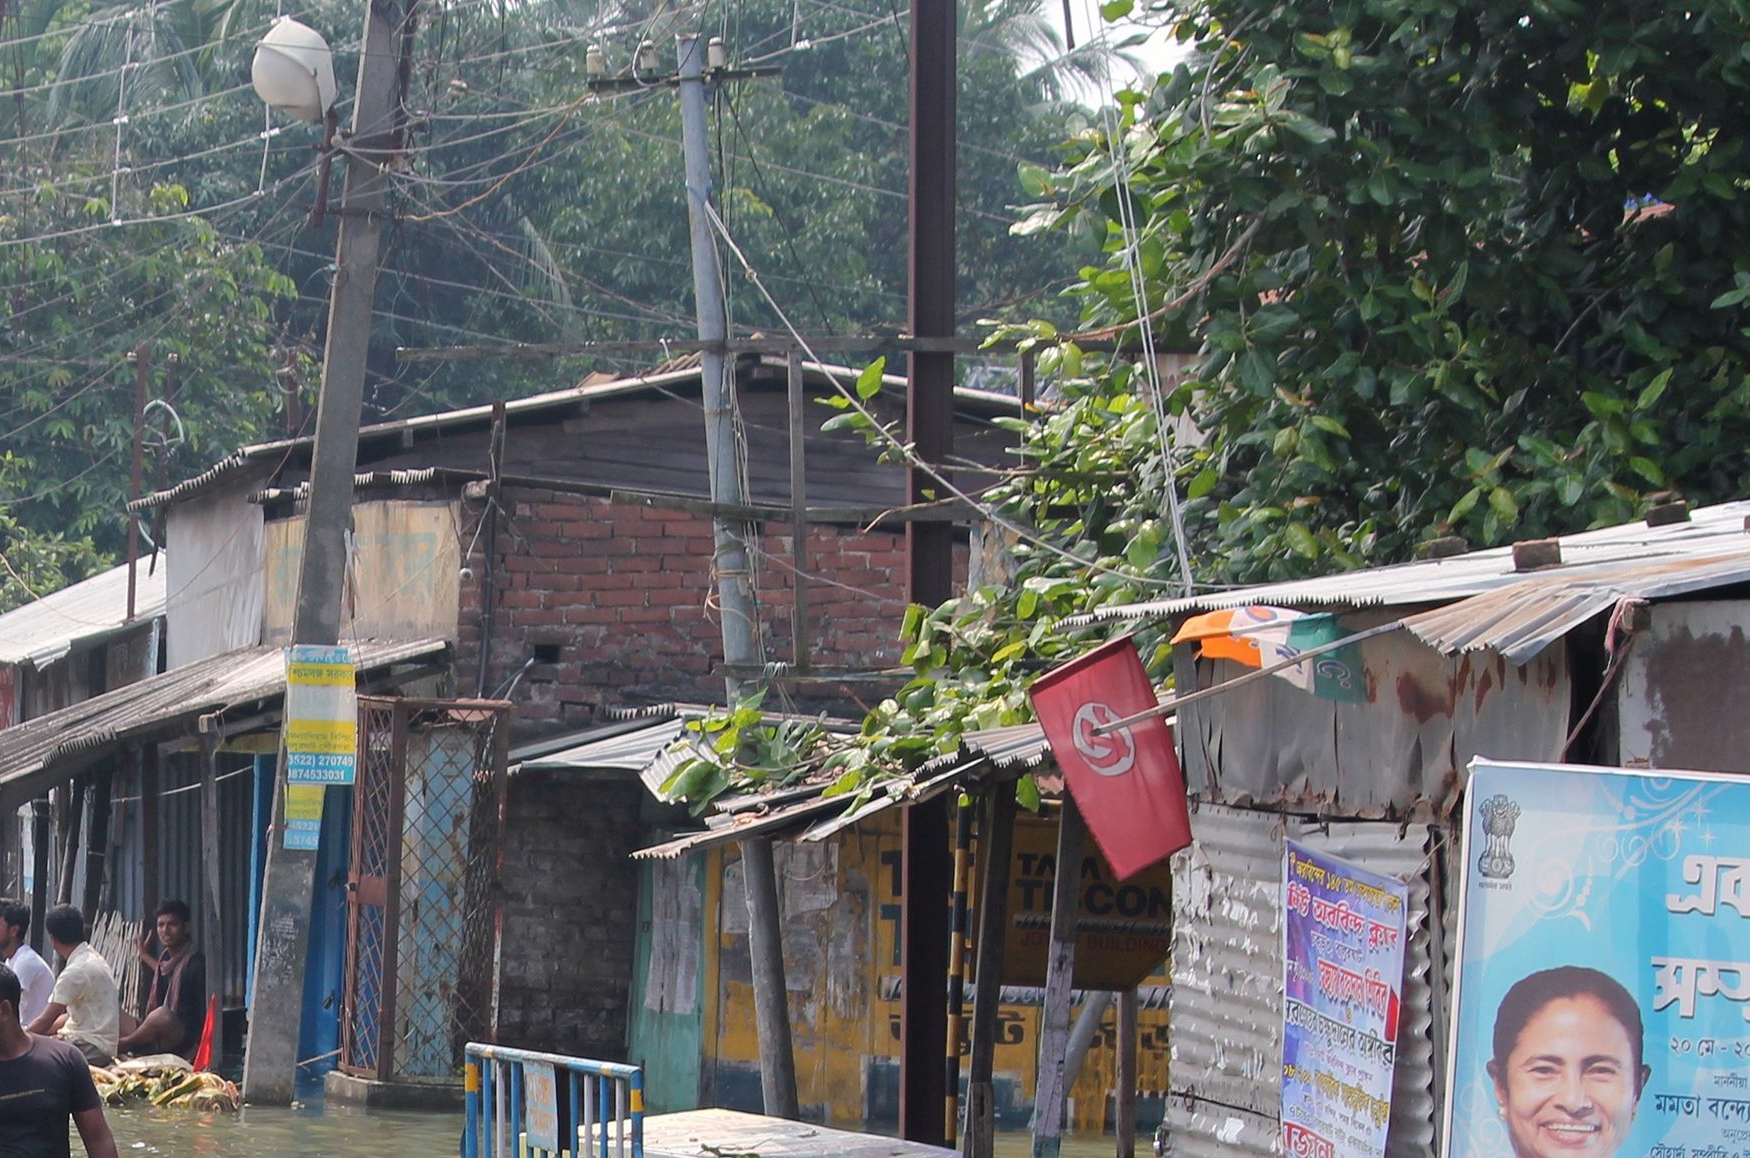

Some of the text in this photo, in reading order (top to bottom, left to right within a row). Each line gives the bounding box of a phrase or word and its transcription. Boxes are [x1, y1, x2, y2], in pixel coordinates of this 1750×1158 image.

[1312, 896, 1366, 936] অরবিন্দ
[1670, 1036, 1691, 1057] ২০
[1697, 1039, 1715, 1057] মে
[1713, 1072, 1748, 1089] মাননীয়া
[1654, 1093, 1701, 1118] মমতা
